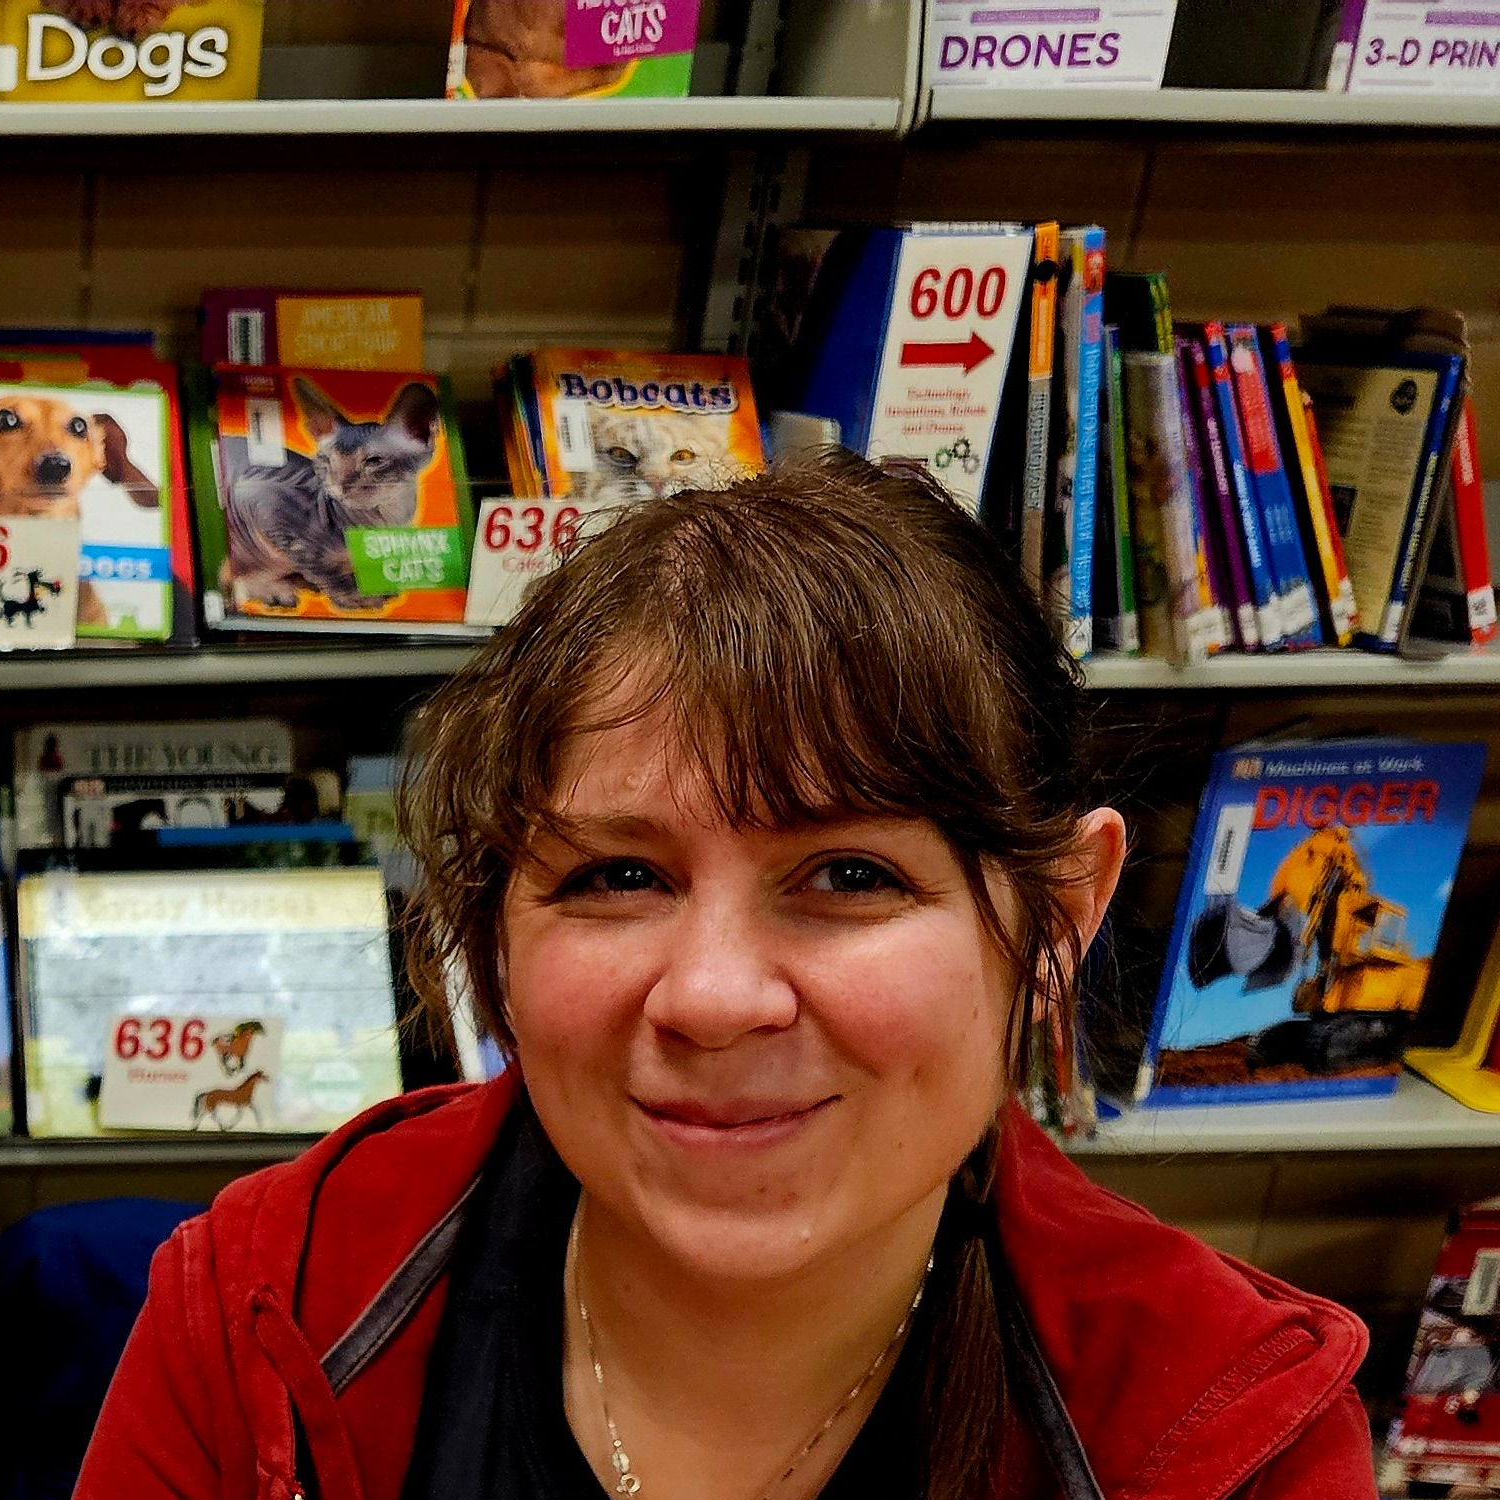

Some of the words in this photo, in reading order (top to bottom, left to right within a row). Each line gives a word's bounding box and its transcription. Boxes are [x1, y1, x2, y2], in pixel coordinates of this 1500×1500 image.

[601, 3, 666, 44] CATS
[25, 13, 229, 97] Dogs
[940, 32, 1121, 69] DRONES
[1365, 37, 1420, 66] 3-D
[1428, 38, 1500, 67] PRIN
[909, 265, 1007, 320] 600
[559, 373, 732, 411] Bobcats
[363, 529, 450, 557] SPHYNX
[485, 507, 579, 554] 636
[381, 557, 445, 582] CATS
[1251, 778, 1440, 831] DIGGER
[115, 1017, 207, 1061] 636
